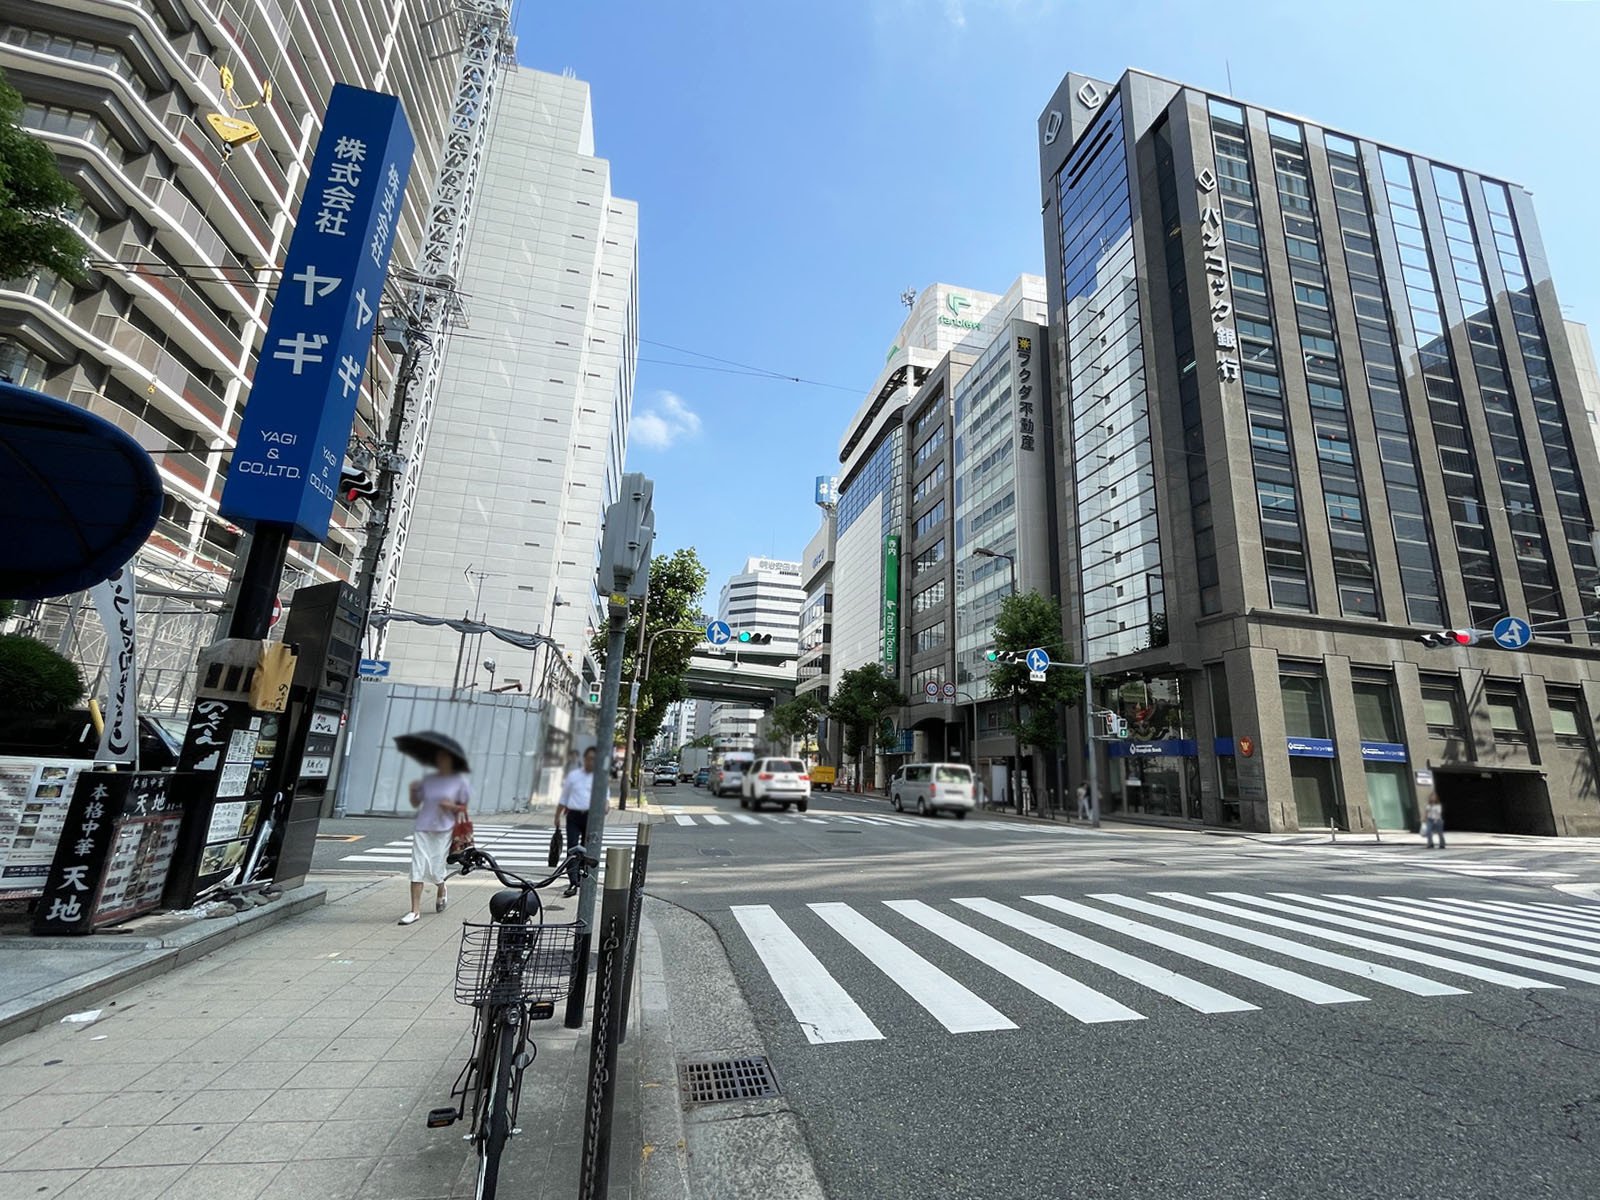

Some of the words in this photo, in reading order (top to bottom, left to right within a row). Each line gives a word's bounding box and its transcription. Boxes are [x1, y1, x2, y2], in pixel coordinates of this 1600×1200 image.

[315, 136, 367, 237] 株式会社
[371, 162, 400, 269] 株式会社
[273, 265, 342, 375] ヤギ
[1201, 207, 1240, 384] バンコック銀行
[337, 288, 373, 398] ヤギ
[1018, 352, 1035, 452] フクダ不動産
[239, 461, 301, 479] CO.,LTD.
[261, 430, 297, 445] YAGI
[267, 448, 280, 460] &
[323, 446, 337, 467] YAGI
[322, 466, 329, 478] &
[74, 783, 109, 857] 本格中華
[134, 791, 166, 814] 天地
[46, 865, 89, 922] 天地
